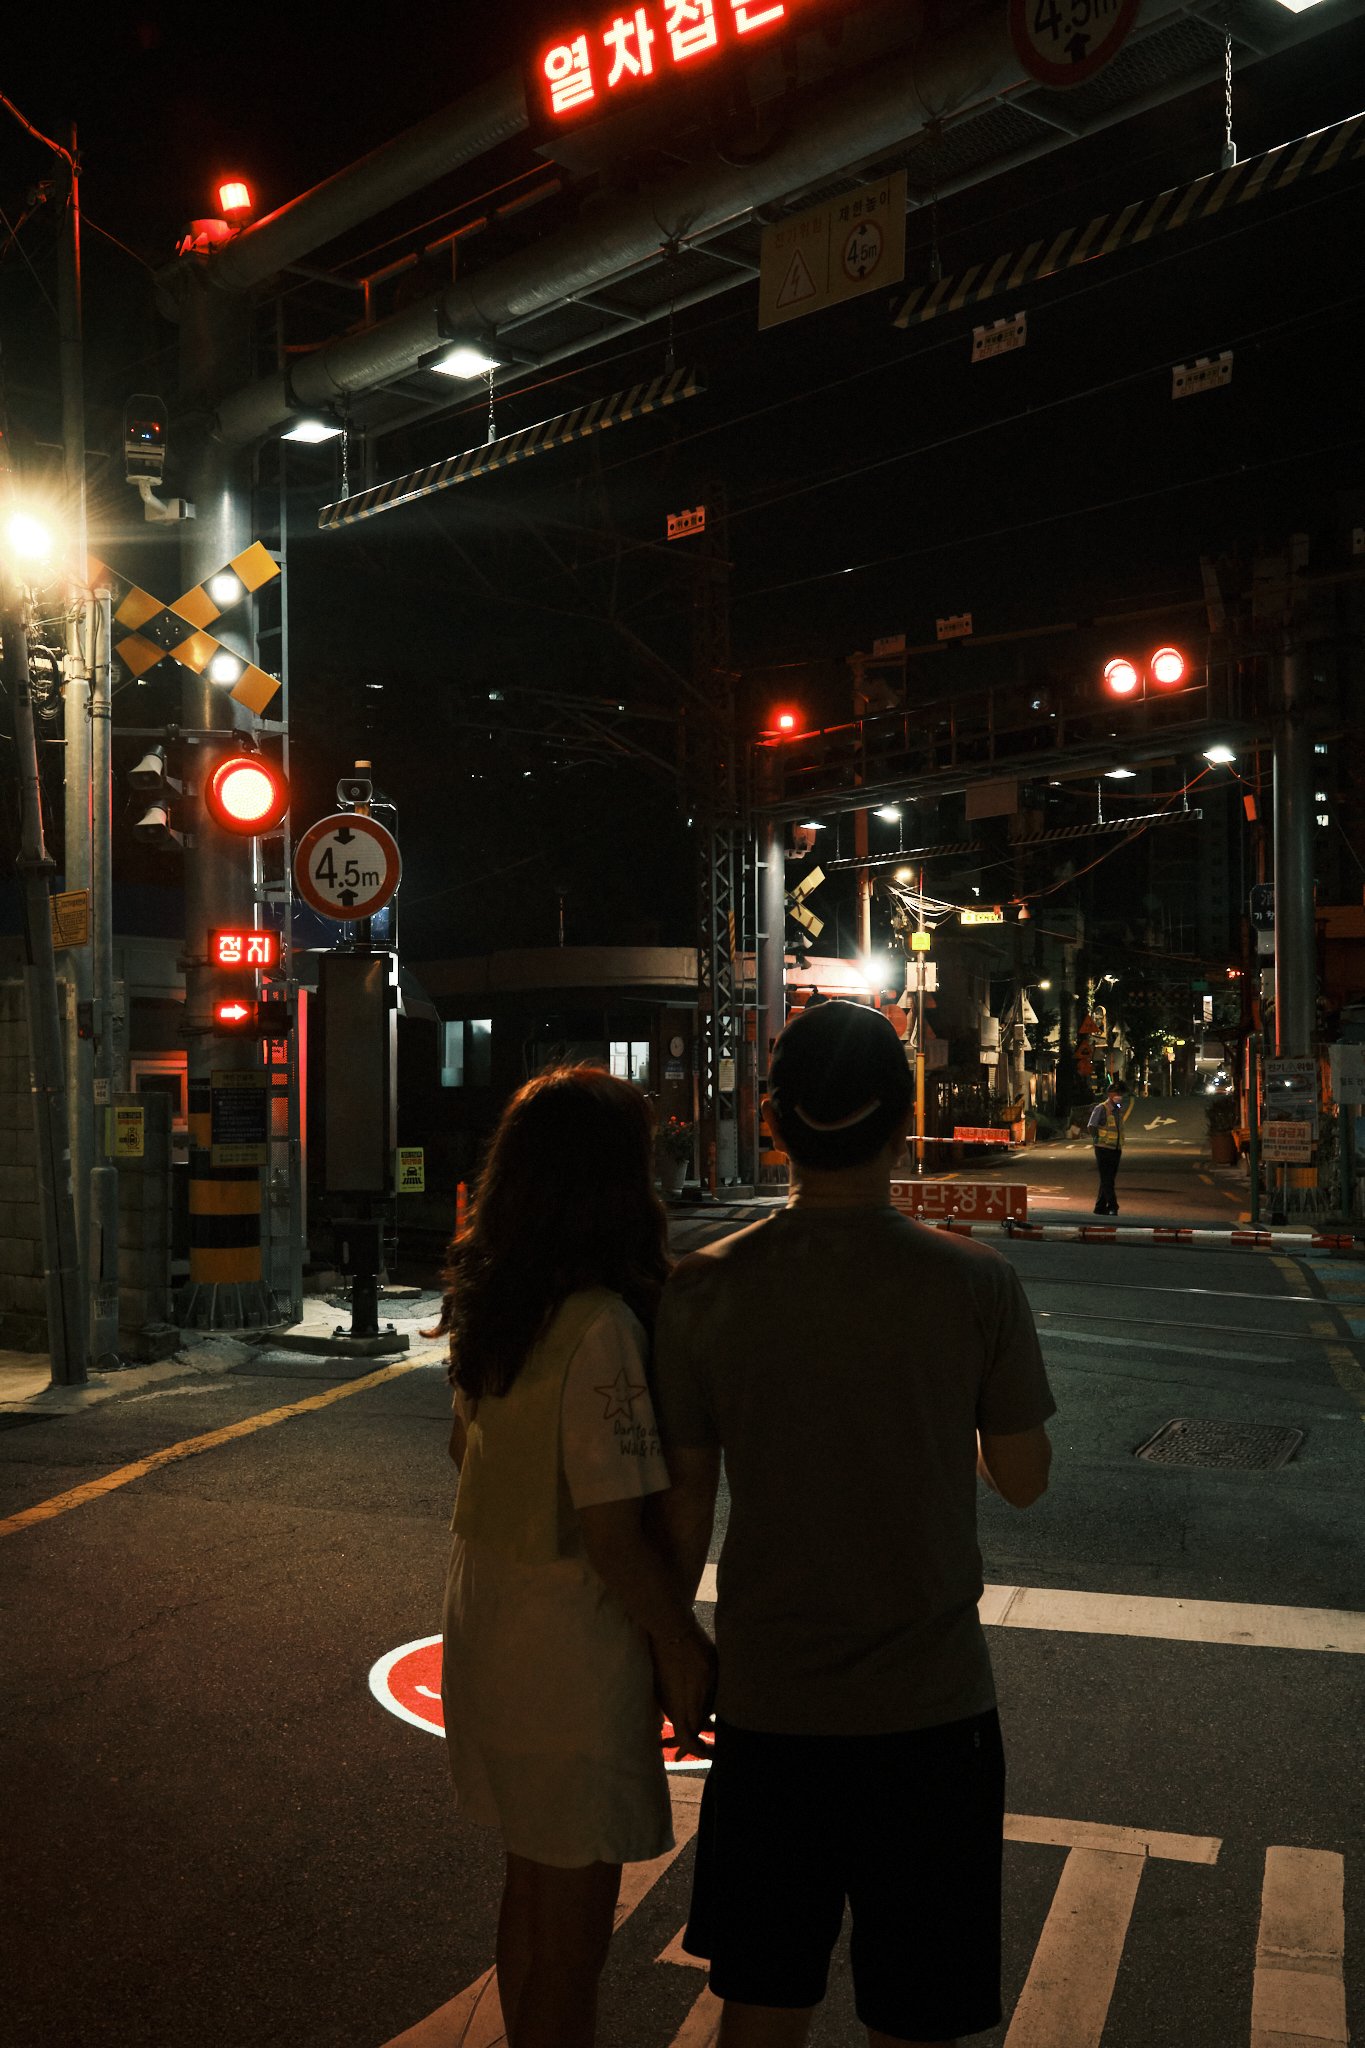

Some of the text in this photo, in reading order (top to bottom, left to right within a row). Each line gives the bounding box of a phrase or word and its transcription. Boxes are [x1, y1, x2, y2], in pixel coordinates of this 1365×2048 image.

[315, 847, 380, 888] 4.5m
[218, 934, 271, 964] 정지
[889, 1184, 1012, 1214] 일단정지
